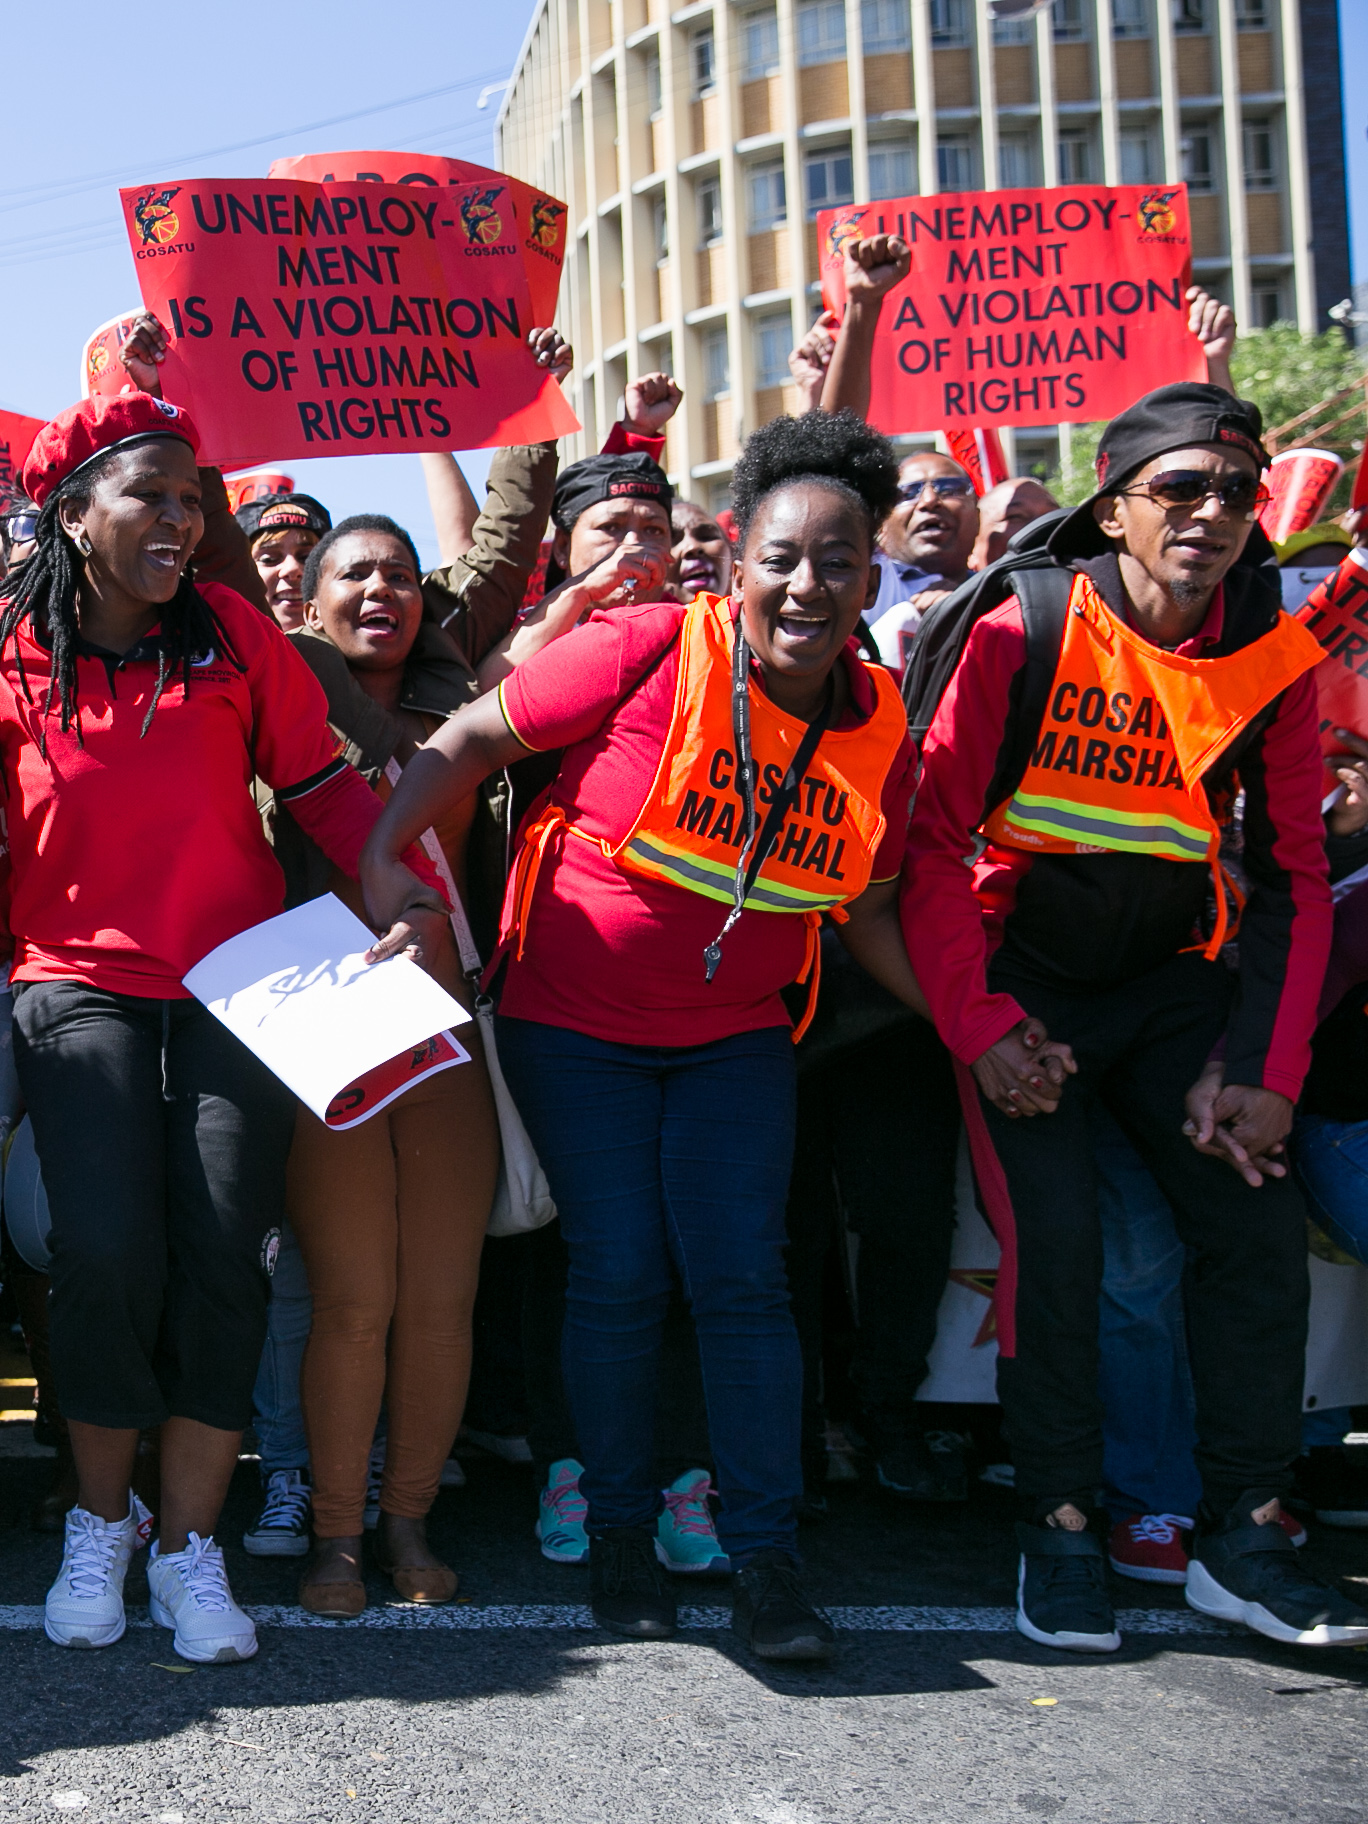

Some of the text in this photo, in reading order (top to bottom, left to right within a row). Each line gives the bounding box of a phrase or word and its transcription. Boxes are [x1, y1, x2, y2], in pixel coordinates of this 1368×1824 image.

[190, 193, 454, 239] UNEMPLOY-
[136, 242, 196, 260] COSATU
[277, 245, 400, 289] MENT
[463, 244, 517, 258] COSATU
[525, 239, 561, 266] COSATU
[946, 242, 1068, 284] MENT
[168, 297, 214, 339] IS
[230, 296, 265, 339] A
[272, 294, 522, 341] VIOLATION
[893, 278, 1182, 332] A VIOLATION
[240, 344, 480, 392] OF HUMAN
[898, 325, 1127, 375] OF HUMAN
[944, 373, 1087, 417] RIGHTS
[297, 398, 452, 443] RIGHTS
[610, 482, 660, 495] SACTWU
[259, 514, 307, 528] SACTWU
[1031, 731, 1184, 790] MARSHA
